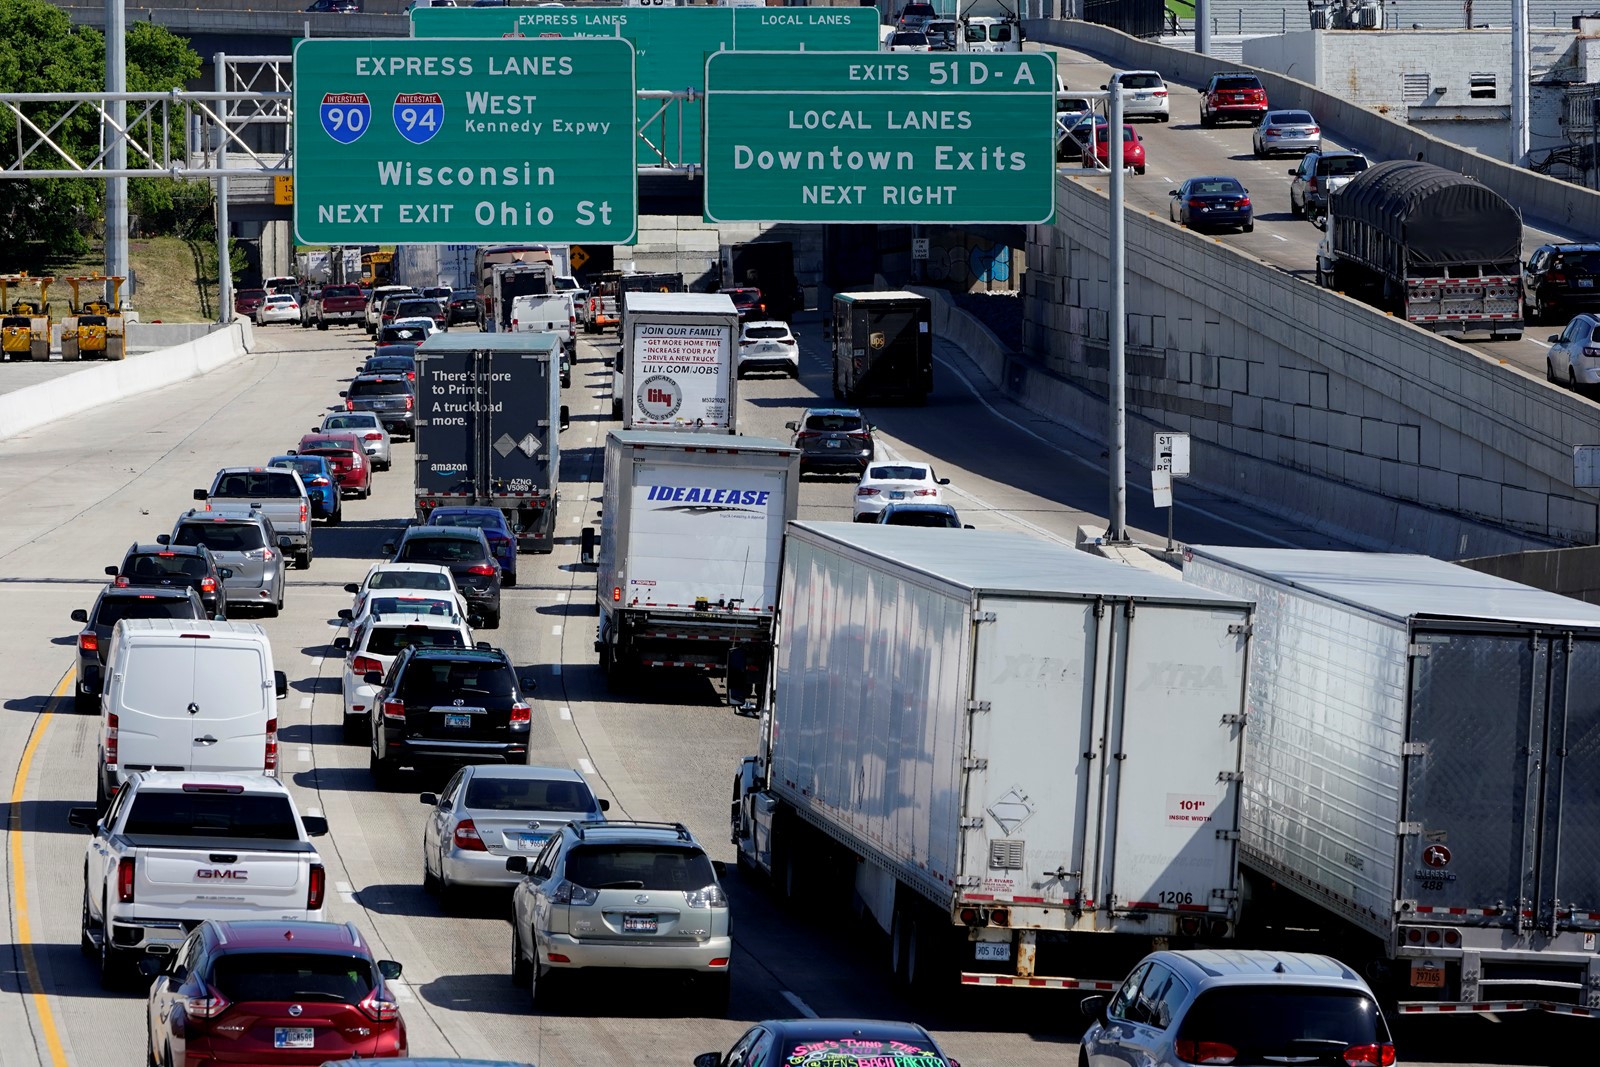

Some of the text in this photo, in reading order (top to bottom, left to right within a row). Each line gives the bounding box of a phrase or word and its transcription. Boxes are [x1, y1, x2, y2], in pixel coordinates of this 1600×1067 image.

[518, 14, 628, 25] EXPRESS LANES
[761, 15, 851, 25] LOCAL LANES
[356, 57, 573, 75] EXPRESS LANES
[849, 65, 909, 80] EXITS
[327, 95, 364, 103] INTERSTATE
[399, 95, 437, 103] INTERSTATE
[466, 91, 536, 114] WEST
[328, 108, 364, 132] 90
[401, 108, 436, 132] 94
[789, 110, 972, 130] LOCAL LANES
[465, 119, 610, 135] Kennedy Expwy
[734, 145, 1027, 170] Downtown Exits
[378, 161, 555, 186] Wisconsin
[803, 186, 957, 204] NEXT RIGHT
[318, 201, 612, 226] NEXT EXIT Ohio St
[642, 327, 722, 337] JOIN OUR FAMILY
[871, 337, 884, 347] ups
[432, 370, 511, 382] There's more
[643, 365, 719, 375] LILY.COM/JOBS
[644, 375, 676, 386] DEDICATED
[432, 384, 488, 395] to Prime.
[647, 388, 672, 407] lily
[432, 401, 503, 412] A truckload
[660, 398, 682, 420] SYSTEMS
[432, 416, 468, 426] more.
[431, 463, 468, 471] amazon
[647, 485, 770, 506] IDEALEASE
[1179, 800, 1206, 811] 101"
[197, 869, 248, 880] GMC
[1416, 869, 1449, 877] EVEREST
[1421, 880, 1444, 890] 488
[1159, 891, 1193, 905] 1206
[792, 1039, 922, 1056] SHE'S TYING THE
